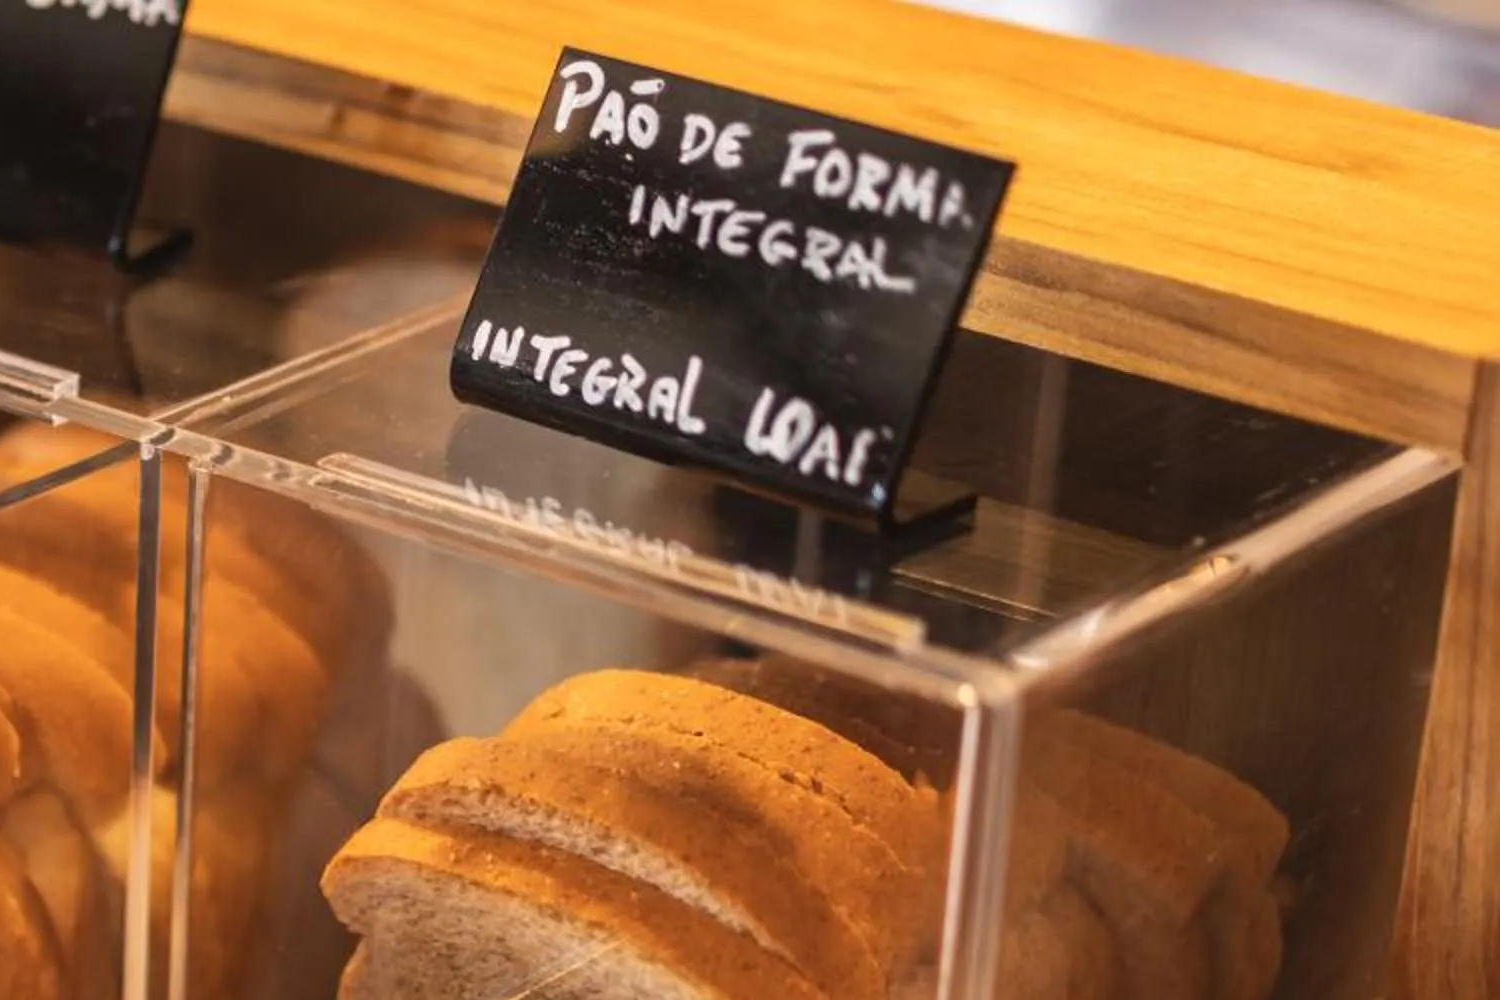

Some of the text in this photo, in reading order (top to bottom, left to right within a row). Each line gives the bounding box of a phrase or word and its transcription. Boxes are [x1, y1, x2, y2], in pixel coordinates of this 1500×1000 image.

[678, 113, 752, 169] DE
[629, 186, 915, 293] INTEGRAL
[471, 320, 705, 434] INTEGRAL
